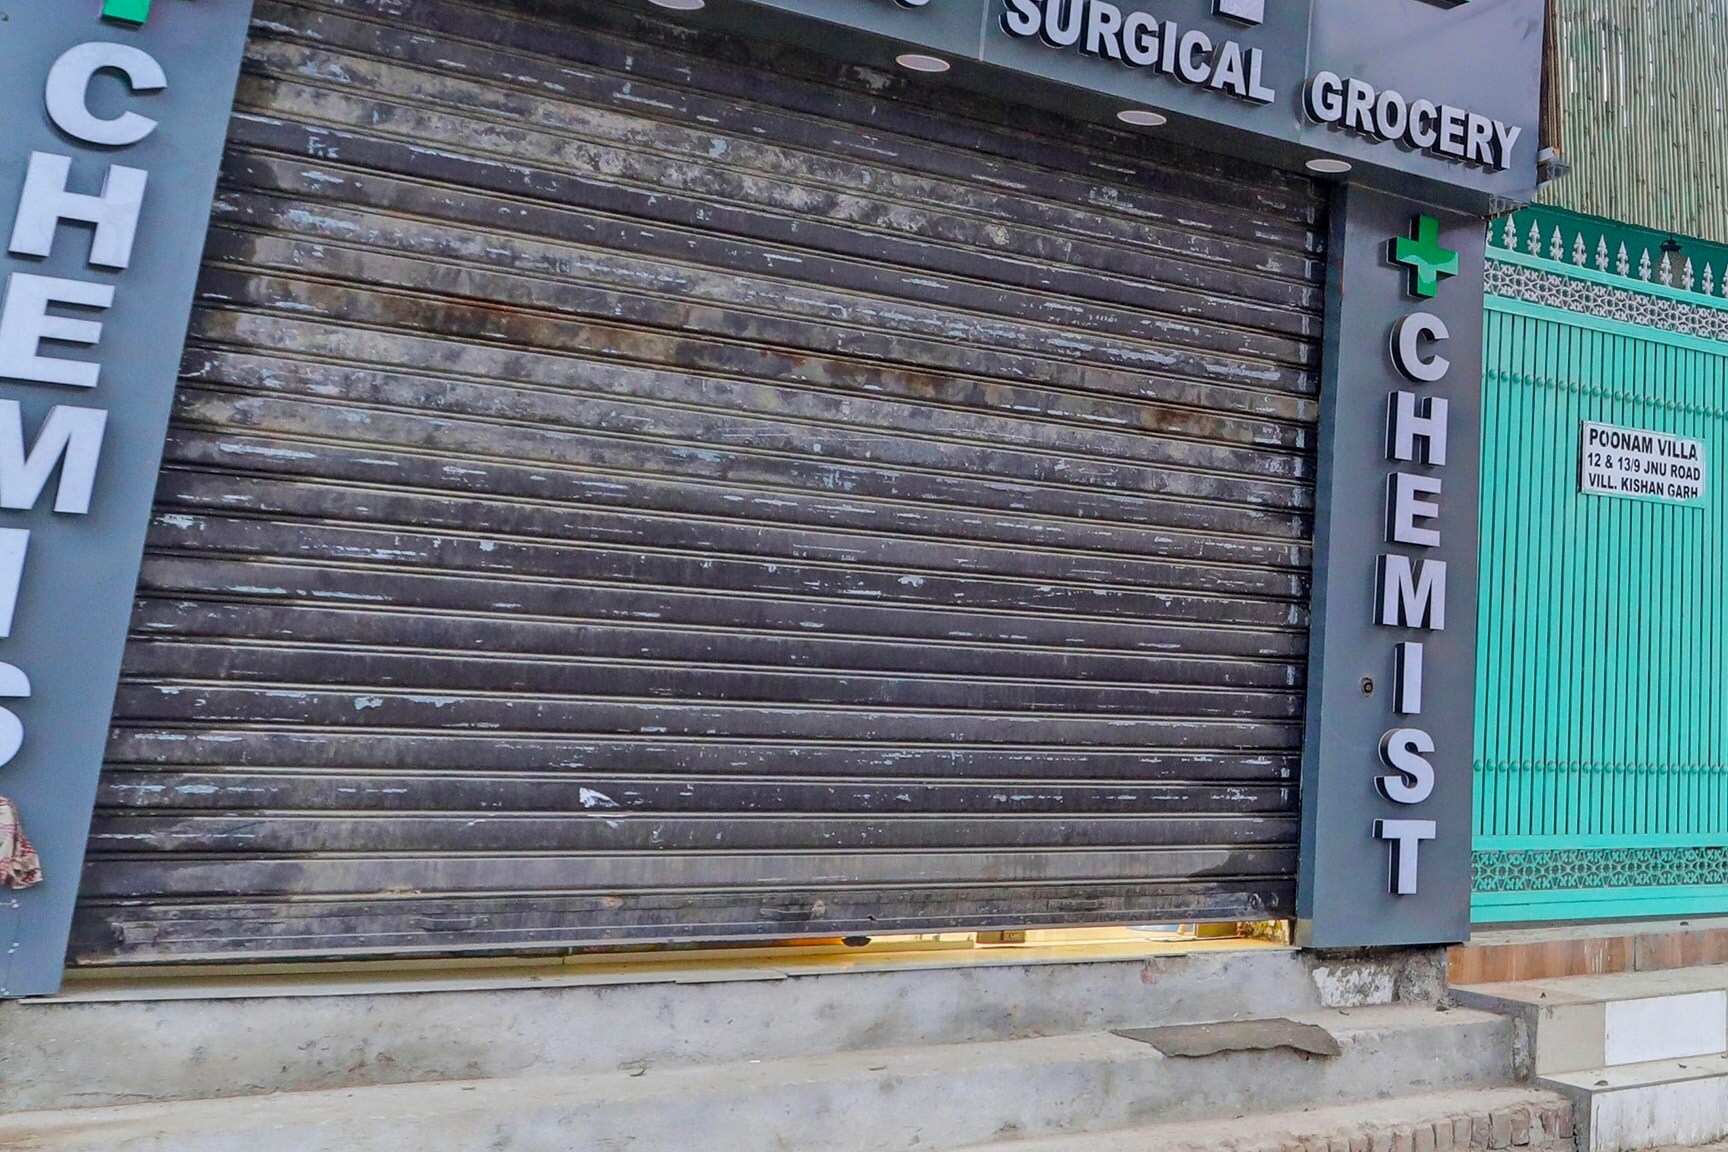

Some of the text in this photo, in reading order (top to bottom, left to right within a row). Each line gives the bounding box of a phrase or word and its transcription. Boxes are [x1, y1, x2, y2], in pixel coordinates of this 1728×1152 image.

[1302, 70, 1523, 172] GROCERY
[1589, 428, 1698, 461] POONAM VILLA
[1587, 452, 1701, 481] 12 & 13/9 JNU ROAD
[1588, 472, 1698, 499] VILL. KISHAN GARH
[1373, 312, 1450, 896] CHEMIST
